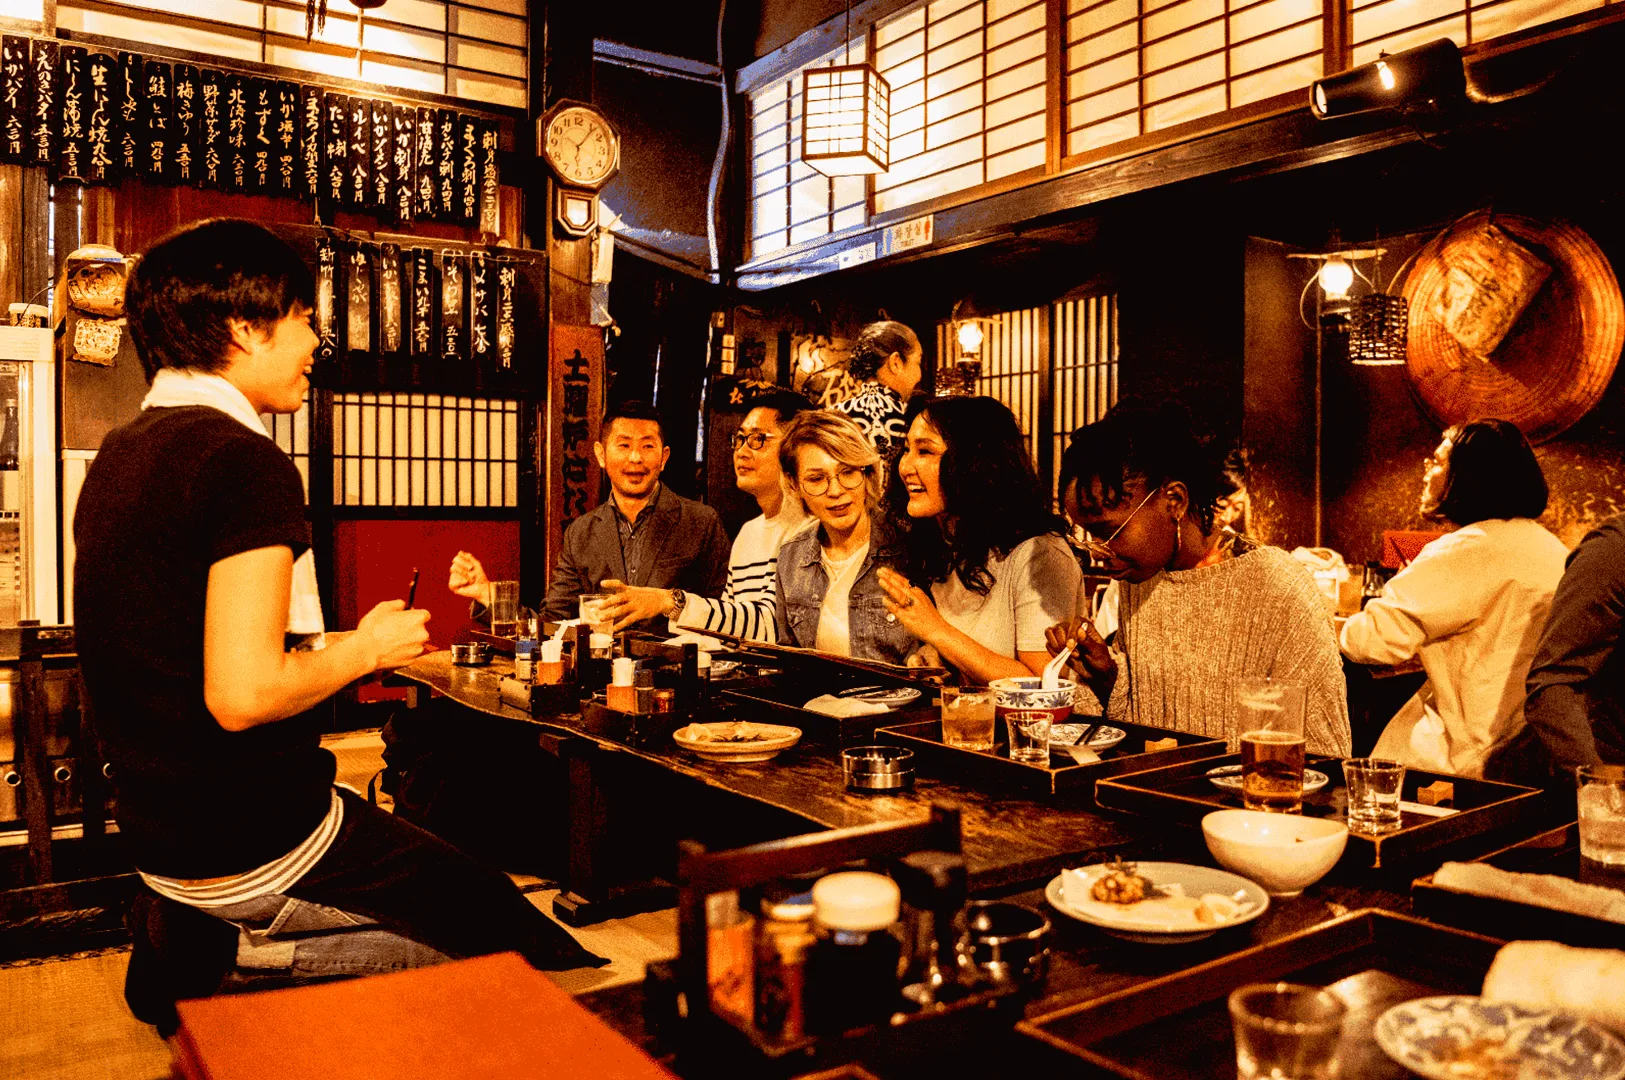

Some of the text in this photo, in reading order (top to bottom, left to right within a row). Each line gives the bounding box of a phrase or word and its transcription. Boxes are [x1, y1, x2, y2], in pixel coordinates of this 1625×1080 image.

[574, 116, 584, 127] 12
[553, 125, 563, 136] 10
[550, 137, 559, 147] 9
[595, 132, 604, 143] 2
[553, 151, 562, 161] 8
[597, 146, 606, 156] 3
[562, 162, 570, 172] 7
[595, 159, 602, 168] 4
[574, 168, 582, 177] 6
[586, 166, 594, 175] 5
